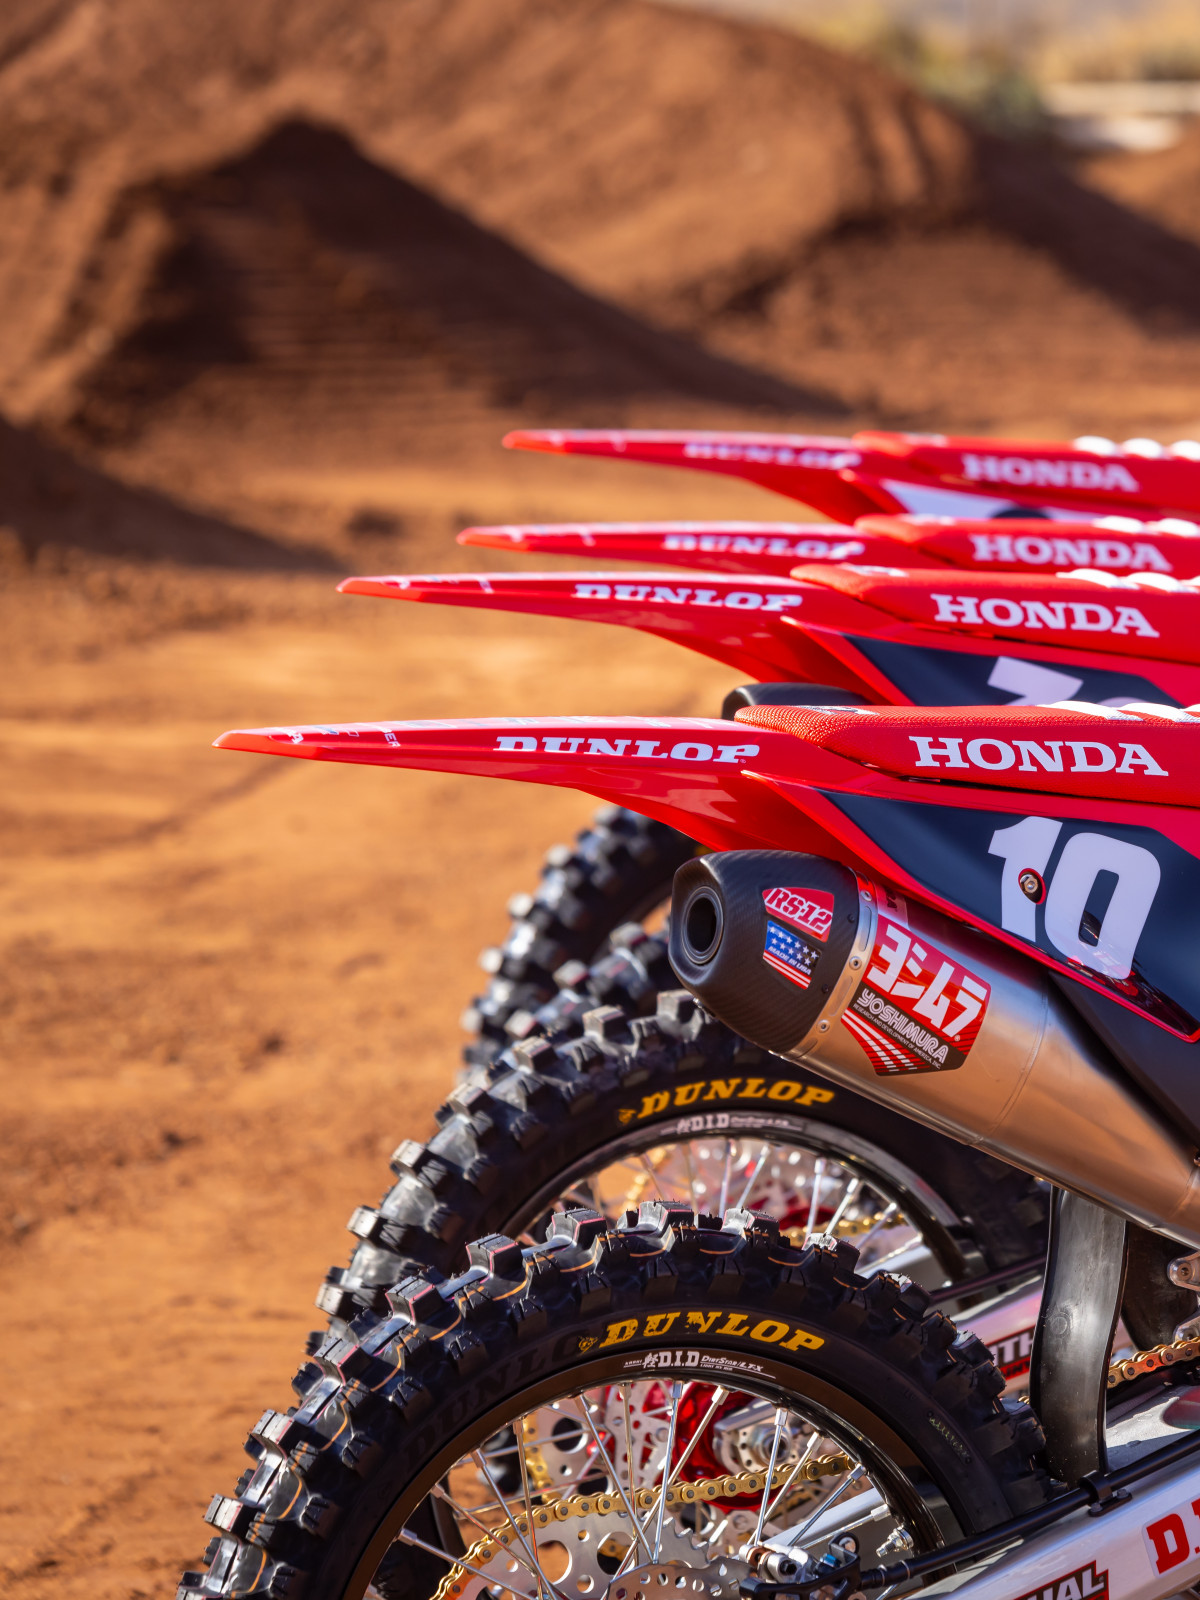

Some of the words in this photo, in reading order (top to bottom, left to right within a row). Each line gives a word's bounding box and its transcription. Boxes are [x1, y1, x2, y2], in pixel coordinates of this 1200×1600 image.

[684, 441, 862, 469] DUNLOP
[962, 454, 1140, 492] HONDA
[663, 534, 865, 559] DUNLOP
[969, 534, 1173, 572] HONDA
[573, 584, 802, 611] DUNLOP
[930, 594, 1160, 638] HONDA
[494, 736, 760, 763] DUNLOP
[909, 735, 1169, 777] HONDA
[987, 815, 1161, 981] 10
[768, 946, 790, 961] MADE
[788, 958, 797, 967] IN
[796, 962, 812, 976] USA
[856, 988, 949, 1064] YOSHIMURA
[637, 1077, 835, 1119] DUNLOP
[599, 1311, 825, 1352] DUNLOP
